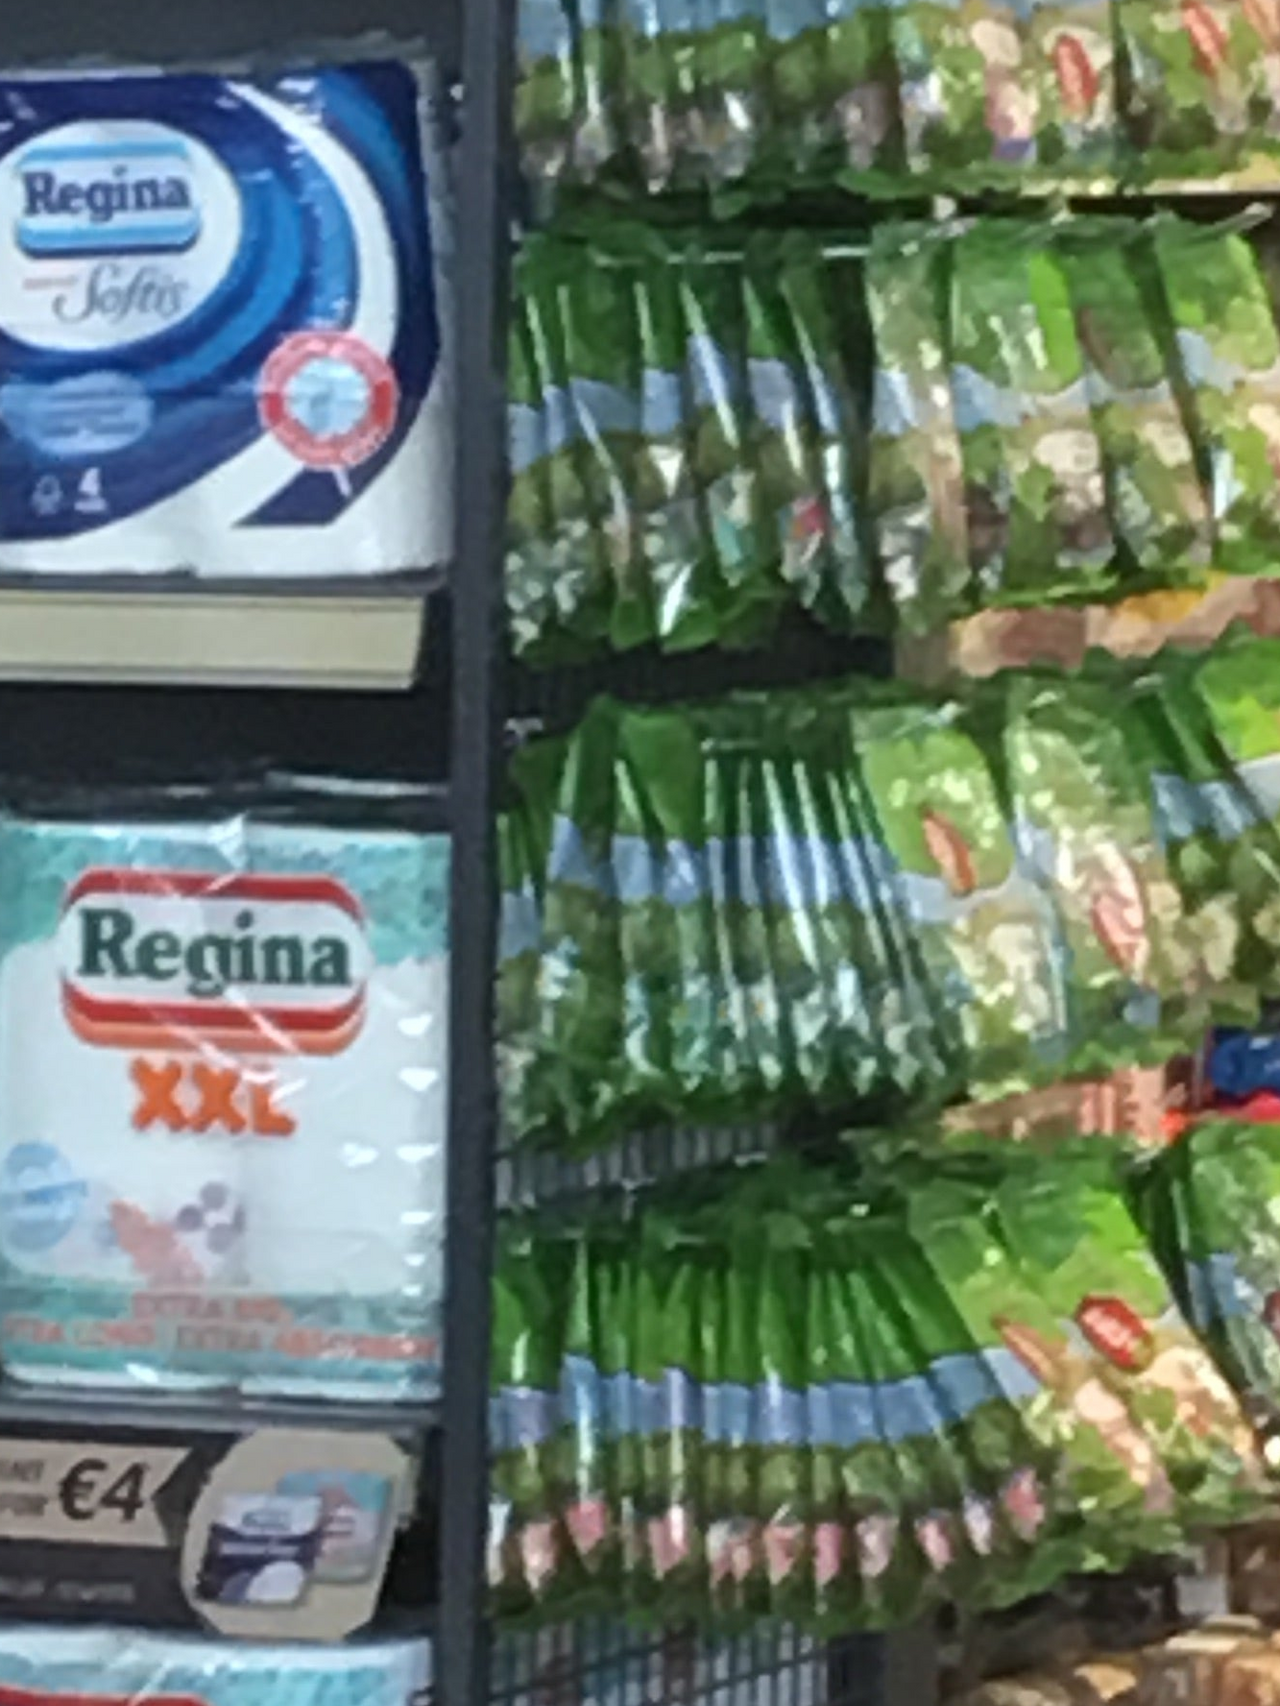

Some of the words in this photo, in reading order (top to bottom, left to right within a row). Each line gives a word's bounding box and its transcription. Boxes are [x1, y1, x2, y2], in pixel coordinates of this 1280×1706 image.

[21, 166, 191, 224] Regina
[76, 907, 351, 997] Regina
[130, 1059, 297, 1137] XXL
[58, 1458, 148, 1523] €4
